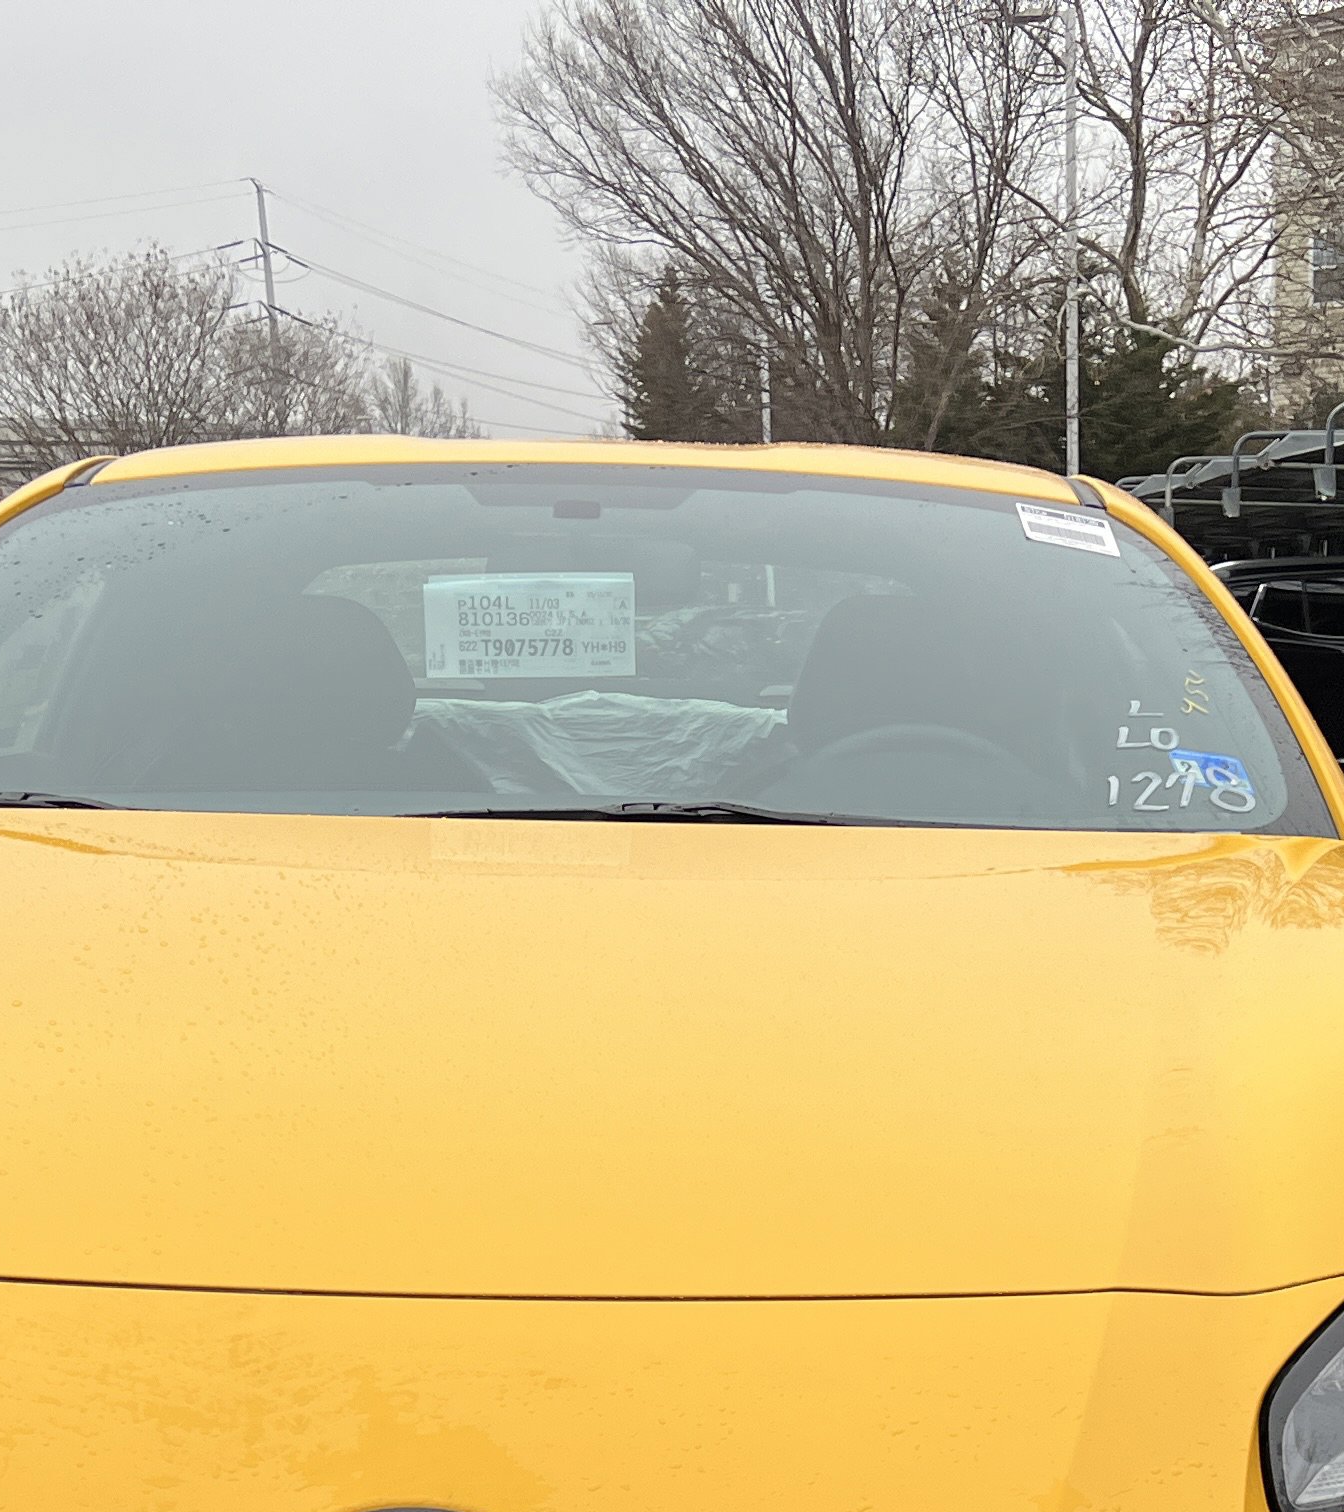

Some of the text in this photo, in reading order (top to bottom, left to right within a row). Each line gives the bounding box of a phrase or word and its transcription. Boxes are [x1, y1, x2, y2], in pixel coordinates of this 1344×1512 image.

[618, 600, 628, 610] A
[458, 611, 530, 627] 810136
[481, 638, 575, 656] T9075778
